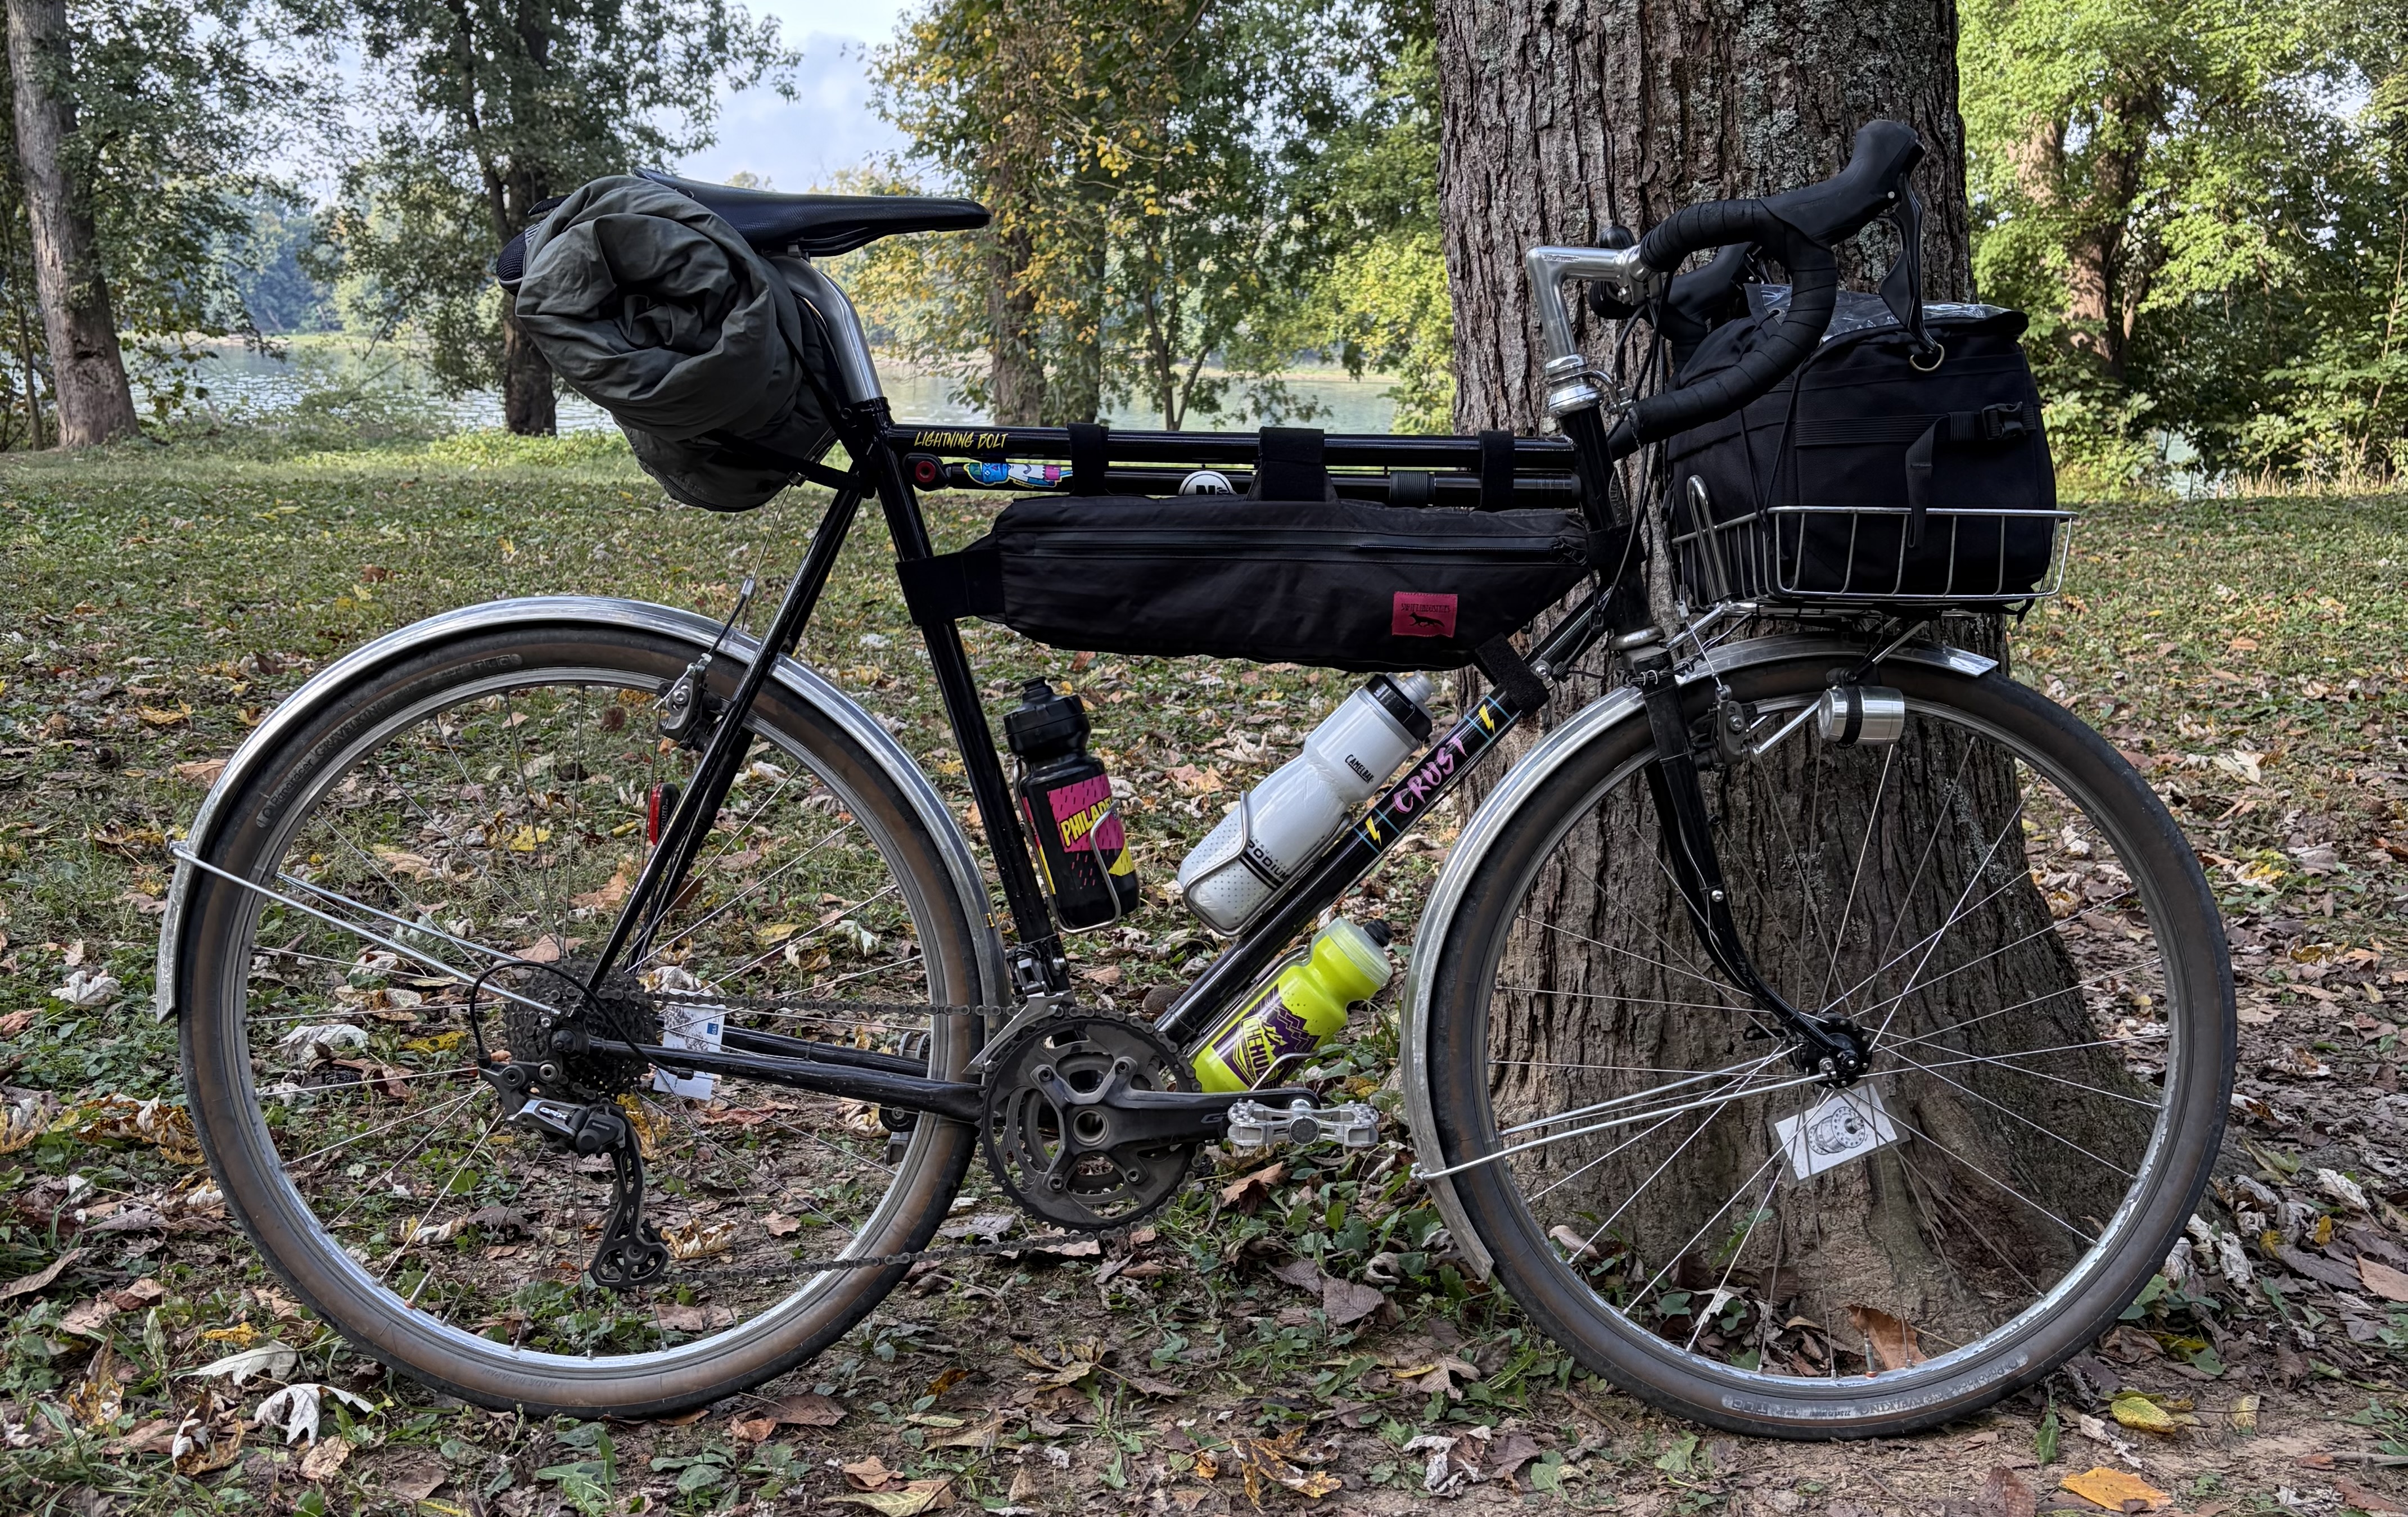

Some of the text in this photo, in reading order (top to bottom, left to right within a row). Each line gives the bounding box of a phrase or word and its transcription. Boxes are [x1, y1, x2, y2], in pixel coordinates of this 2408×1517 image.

[914, 431, 1008, 449] LIGHTNING BOLT
[270, 757, 315, 806] Panaracer
[1393, 733, 1468, 814] CRUST
